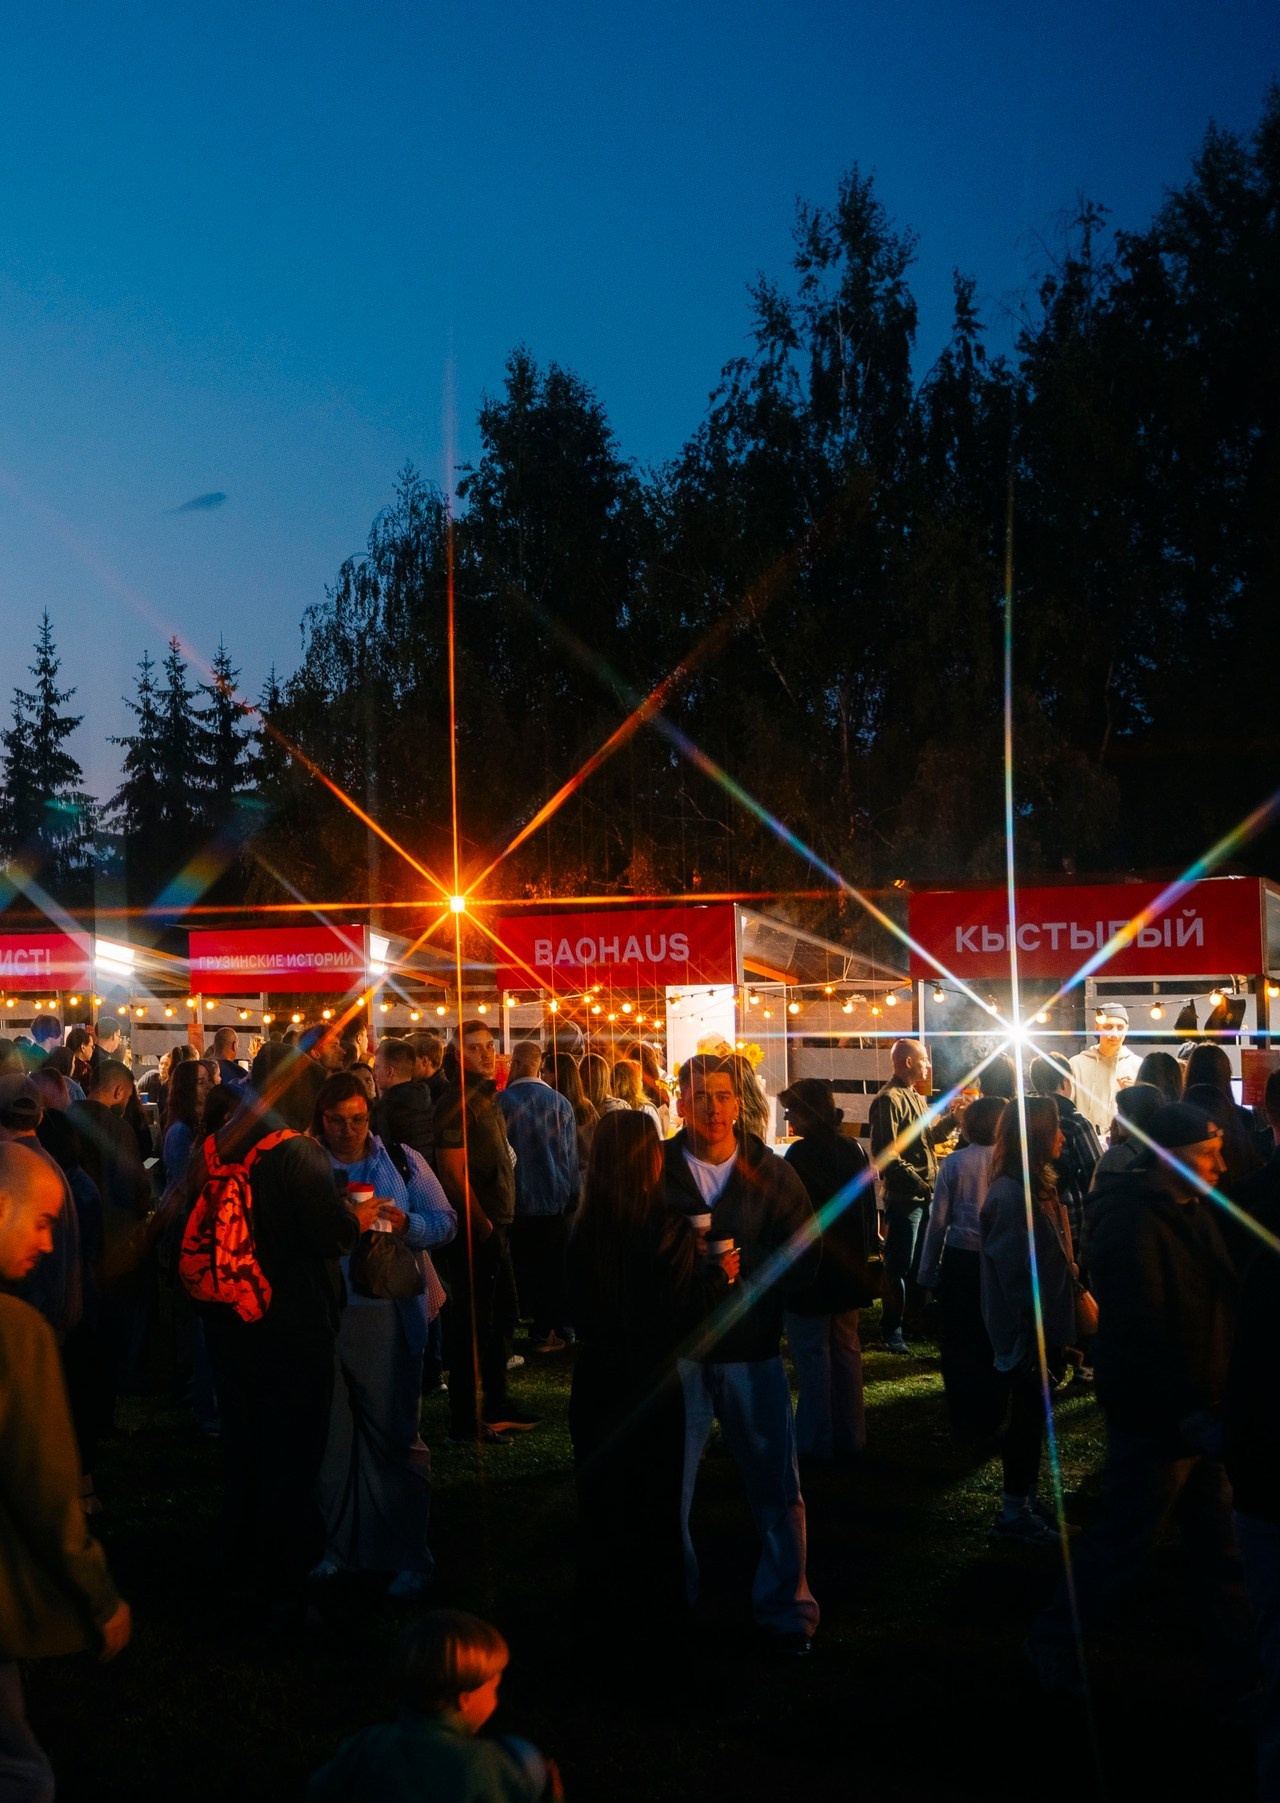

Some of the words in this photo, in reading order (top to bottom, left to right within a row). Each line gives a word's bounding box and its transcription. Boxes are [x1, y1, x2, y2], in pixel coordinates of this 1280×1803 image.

[955, 909, 1204, 953] КЫСТЫБЫЙ
[198, 953, 284, 969] ГРУЗИНСКИЕ
[287, 952, 354, 967] ИСТОРИИ
[534, 933, 690, 966] BAOHAUS
